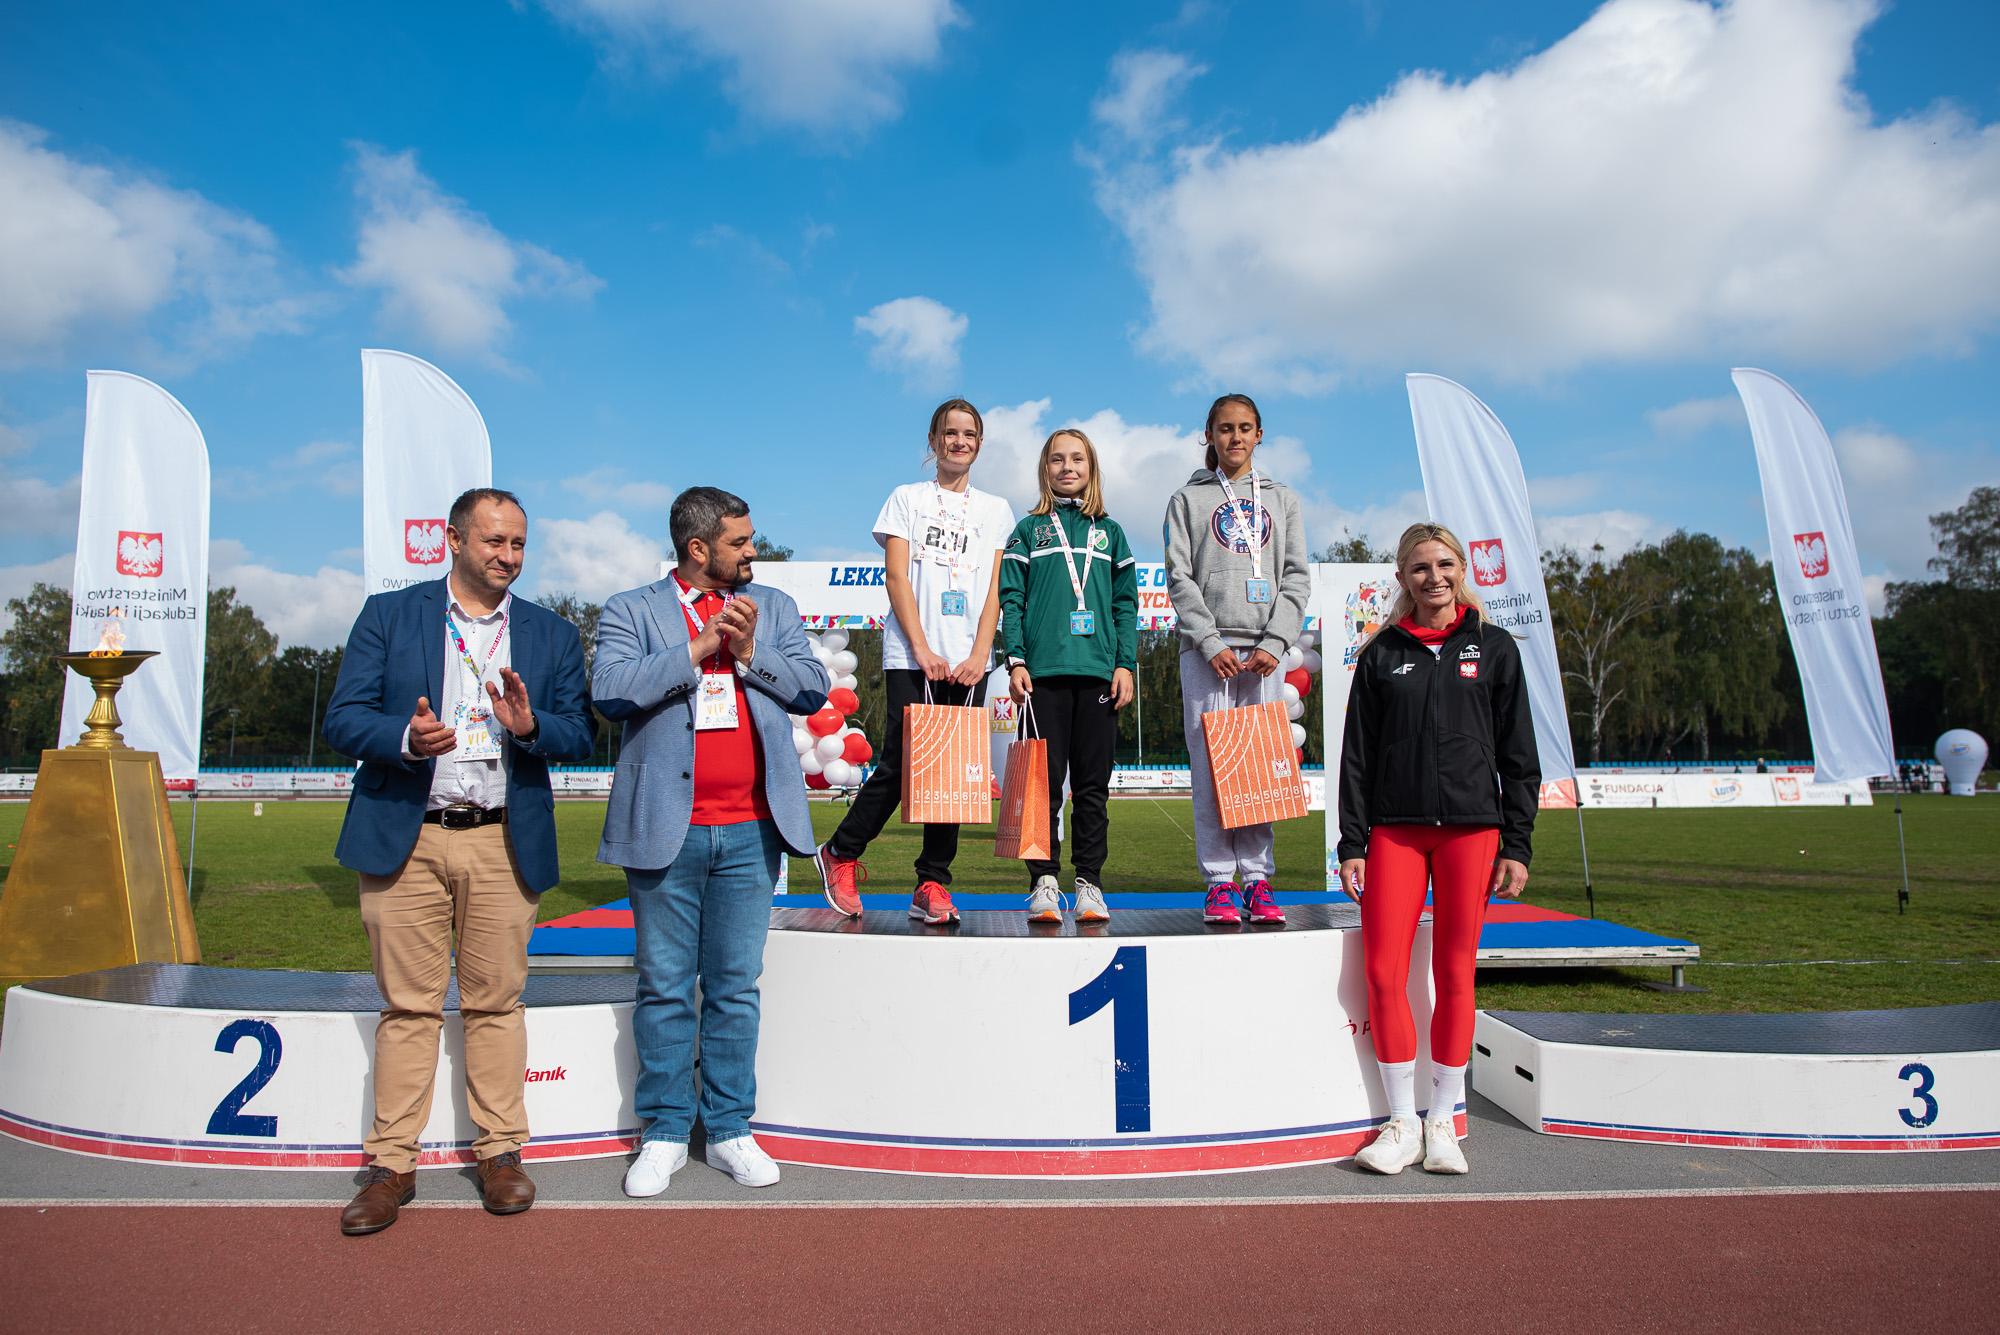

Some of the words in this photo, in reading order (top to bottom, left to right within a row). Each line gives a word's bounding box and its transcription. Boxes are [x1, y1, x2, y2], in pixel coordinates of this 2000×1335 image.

[1392, 663, 1416, 675] 4F
[706, 703, 724, 715] VIP
[991, 721, 1017, 731] PZLA
[468, 731, 487, 745] VIP
[1604, 784, 1664, 793] FUNDACJA
[915, 790, 920, 799] 1
[924, 790, 930, 800] 2
[934, 791, 939, 800] 3
[943, 791, 949, 800] 4
[953, 792, 959, 800] 5
[962, 792, 968, 801] 6
[972, 792, 978, 801] 7
[982, 792, 987, 801] 8
[1224, 796, 1230, 805] 1
[1233, 794, 1241, 804] 2
[1243, 793, 1250, 803] 3
[1253, 792, 1260, 801] 4
[1263, 790, 1270, 800] 5
[1273, 789, 1280, 798] 6
[1283, 787, 1289, 796] 7
[1293, 786, 1300, 795] 8
[1069, 945, 1151, 1133] 1
[206, 1019, 282, 1137] 2
[1898, 1063, 1939, 1129] 3
